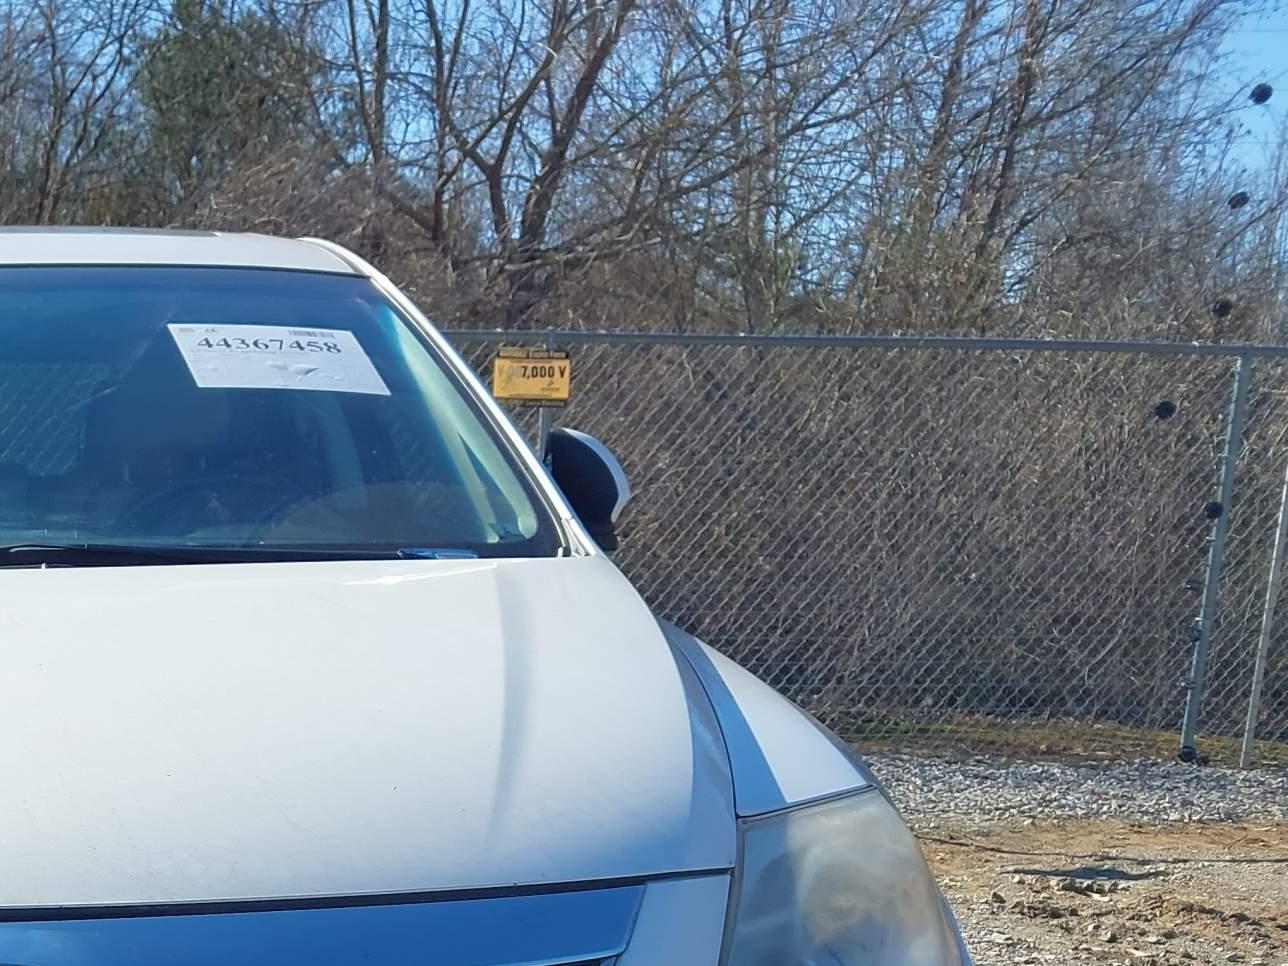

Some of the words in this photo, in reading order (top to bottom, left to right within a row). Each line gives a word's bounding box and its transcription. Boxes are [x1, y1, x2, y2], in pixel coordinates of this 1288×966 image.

[197, 336, 342, 354] 44367458
[520, 365, 556, 379] 7,000
[559, 365, 567, 379] V
